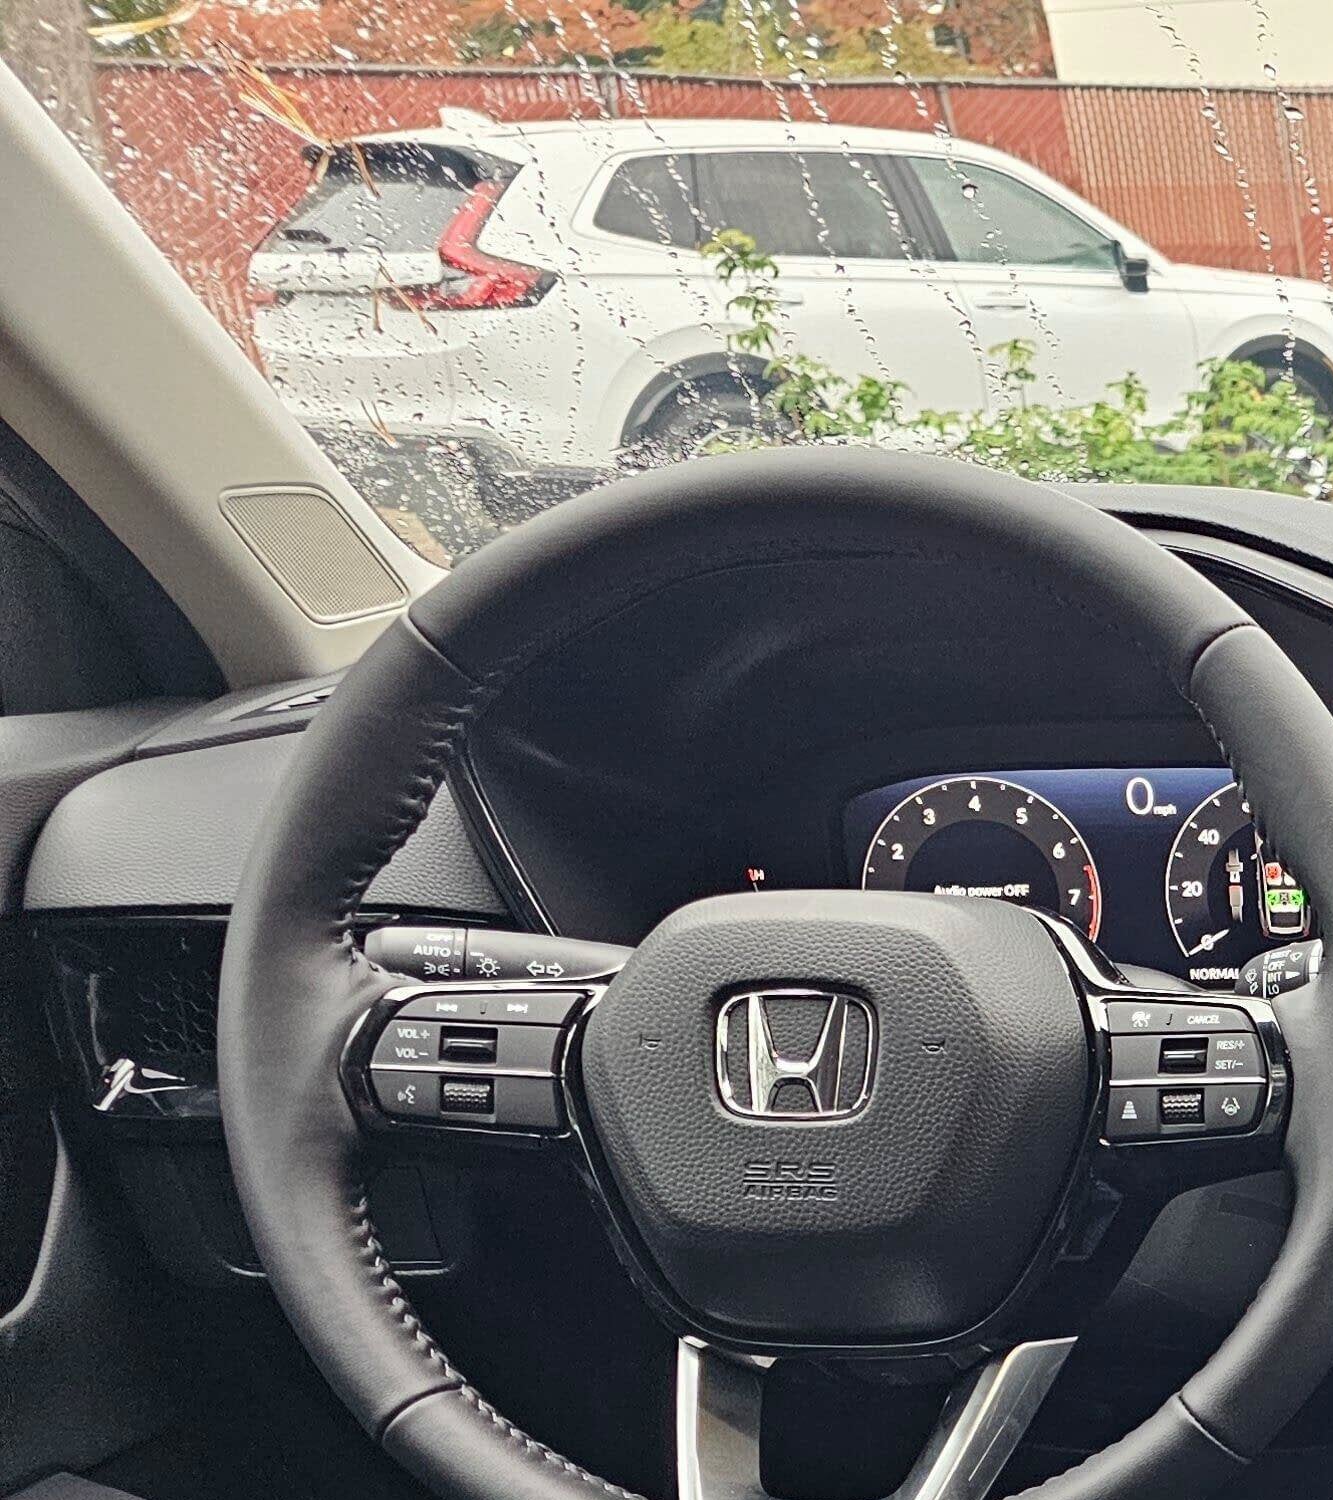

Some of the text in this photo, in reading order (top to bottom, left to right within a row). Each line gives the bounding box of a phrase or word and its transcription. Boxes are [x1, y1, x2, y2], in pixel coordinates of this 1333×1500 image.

[967, 795, 982, 812] 4
[1125, 776, 1178, 817] 0 mph
[922, 808, 936, 825] 3
[1015, 807, 1029, 825] 5
[1197, 828, 1221, 846] 40
[890, 842, 905, 861] 2
[1052, 841, 1066, 860] 6
[1003, 883, 1031, 897] OFF
[1067, 888, 1081, 906] 7
[1181, 880, 1204, 898] 20
[413, 944, 451, 958] AUTO
[1268, 961, 1285, 972] OFF
[1267, 972, 1282, 983] INT
[1267, 983, 1280, 995] LO
[1187, 1014, 1220, 1025] CANCEL
[1216, 1039, 1245, 1051] RES/+
[744, 1161, 837, 1181] SRS
[744, 1184, 839, 1201] AIRBAG
